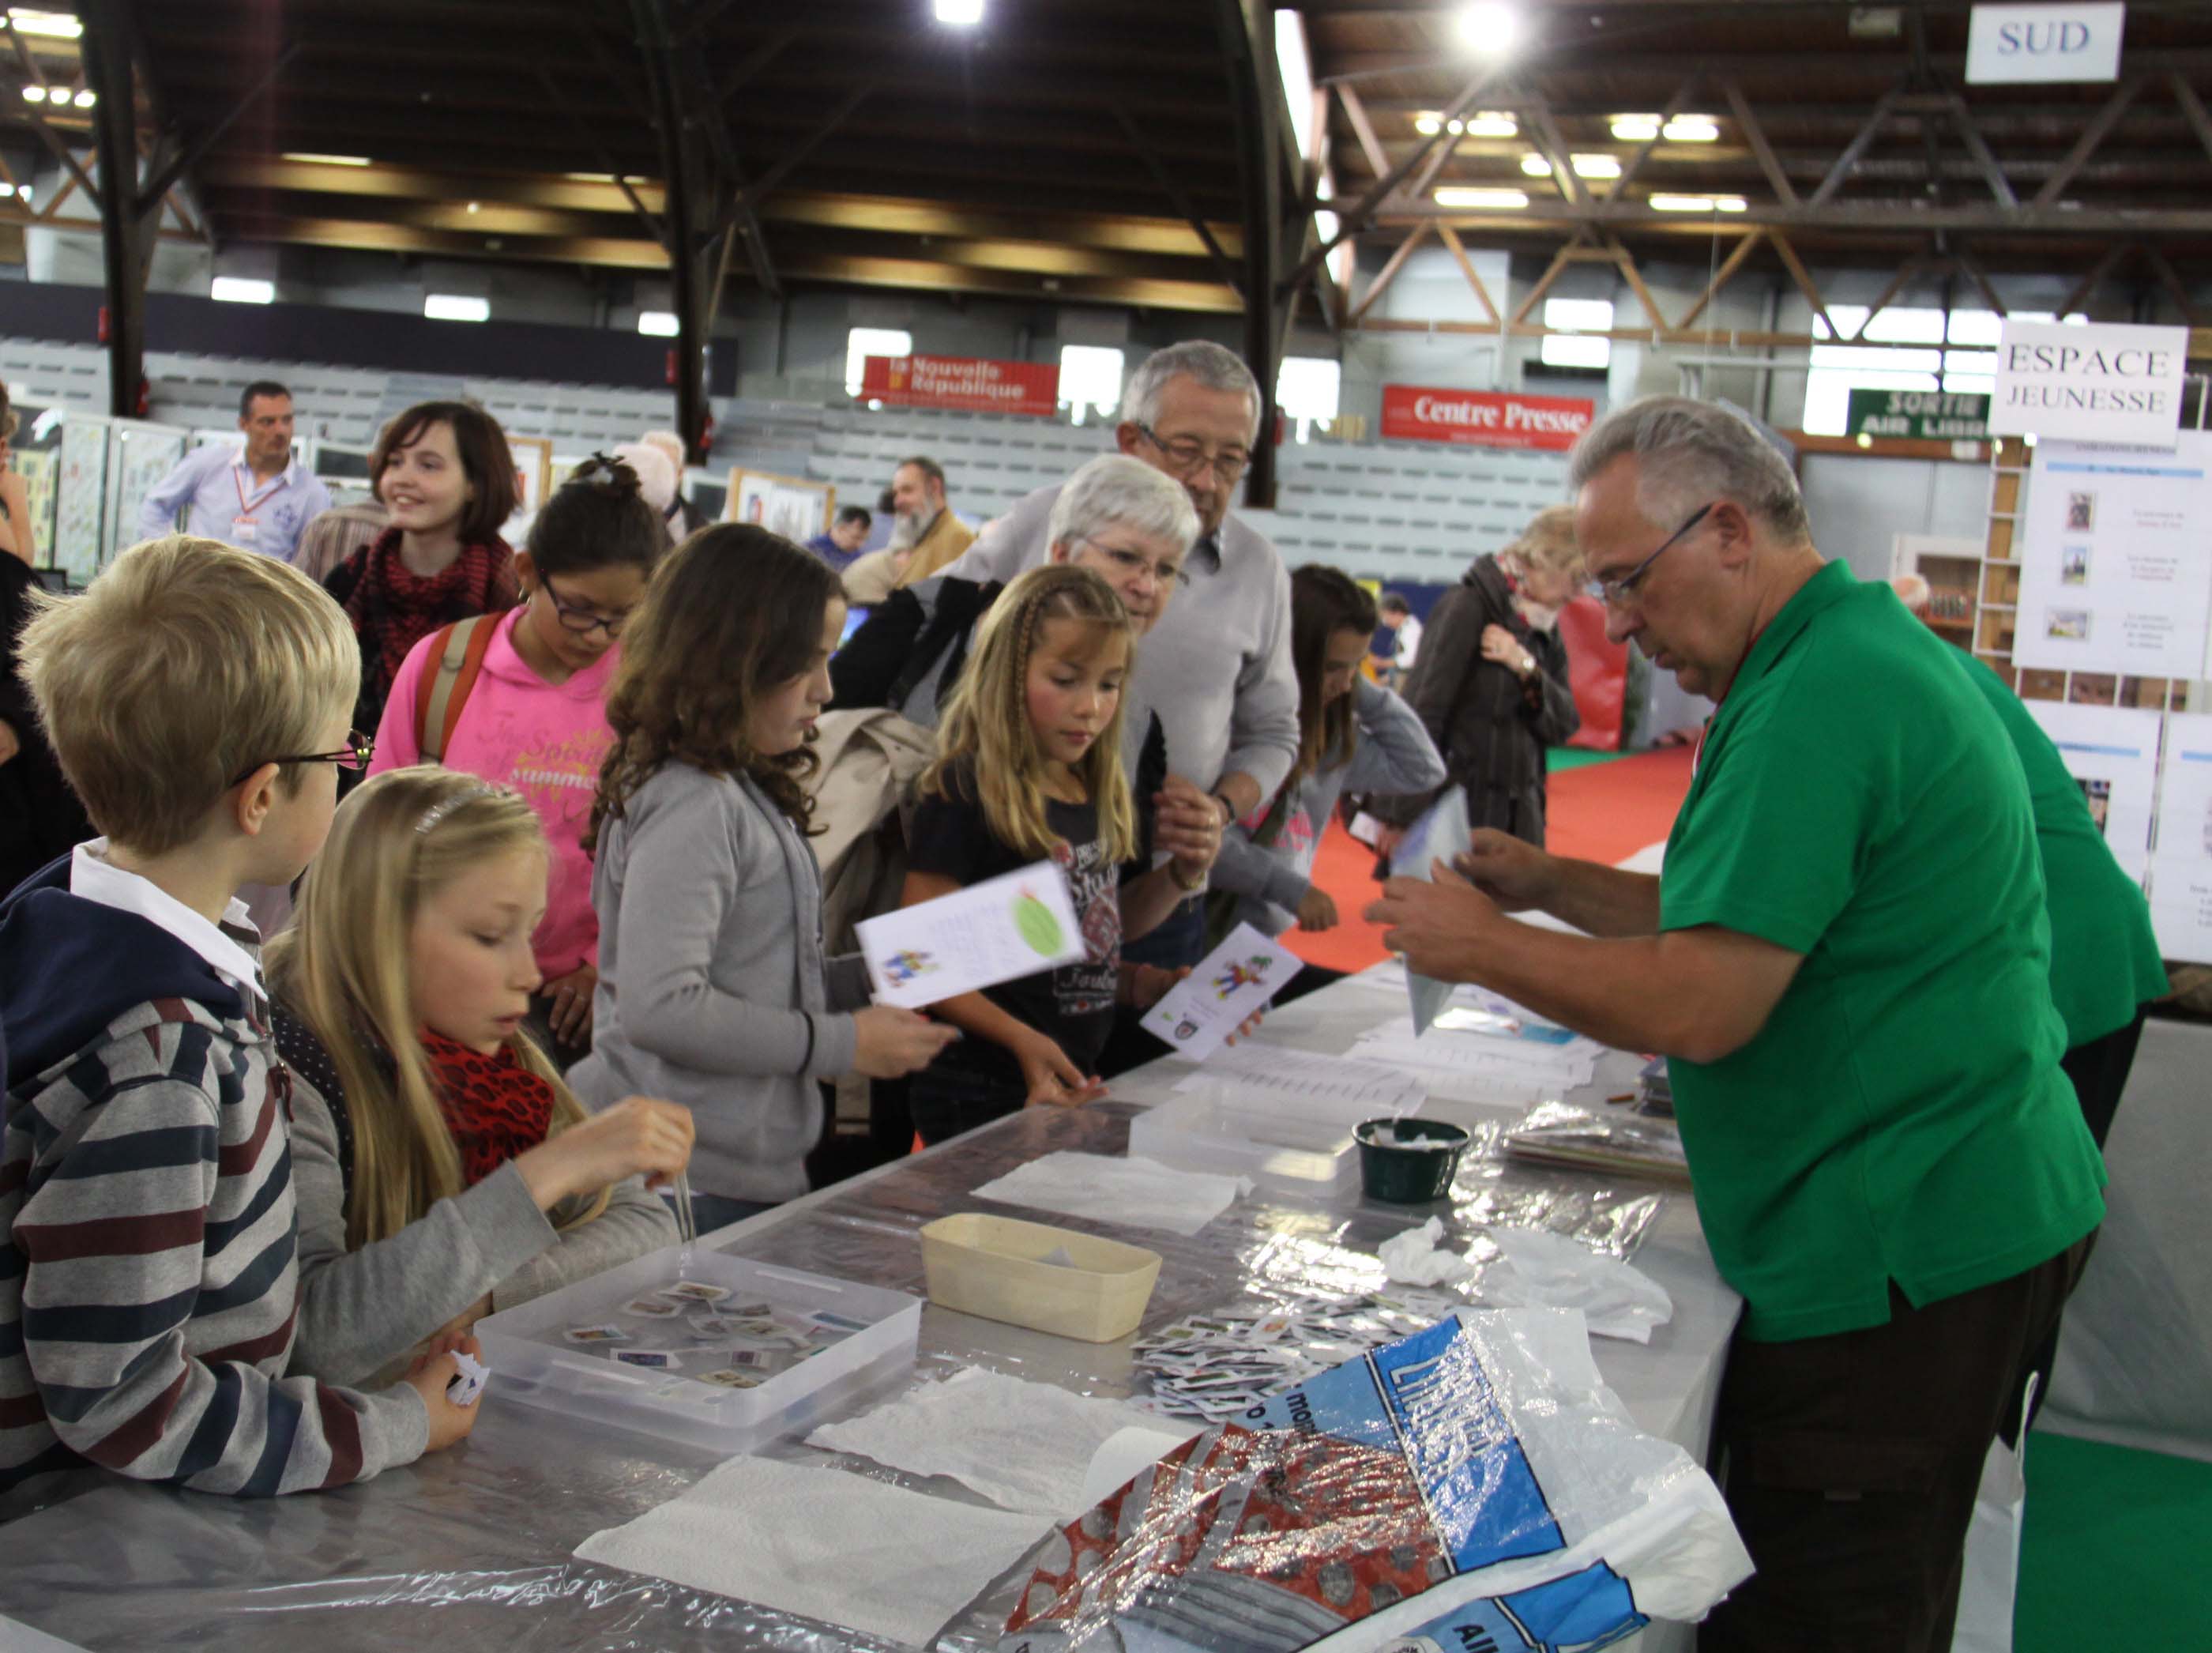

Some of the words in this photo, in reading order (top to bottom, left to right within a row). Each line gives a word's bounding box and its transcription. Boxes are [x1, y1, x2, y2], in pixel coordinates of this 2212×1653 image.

[1998, 21, 2090, 55] SUD
[912, 358, 1002, 379] Nouvelle
[2007, 343, 2170, 378] ESPACE
[1886, 393, 1981, 416] SORTIE
[2007, 385, 2168, 413] JEUNESSE
[1414, 397, 1499, 427] Centre
[1505, 403, 1589, 434] Presse
[1861, 414, 1911, 435] AIR
[1920, 417, 1988, 437] LIBR
[510, 767, 597, 790] summe
